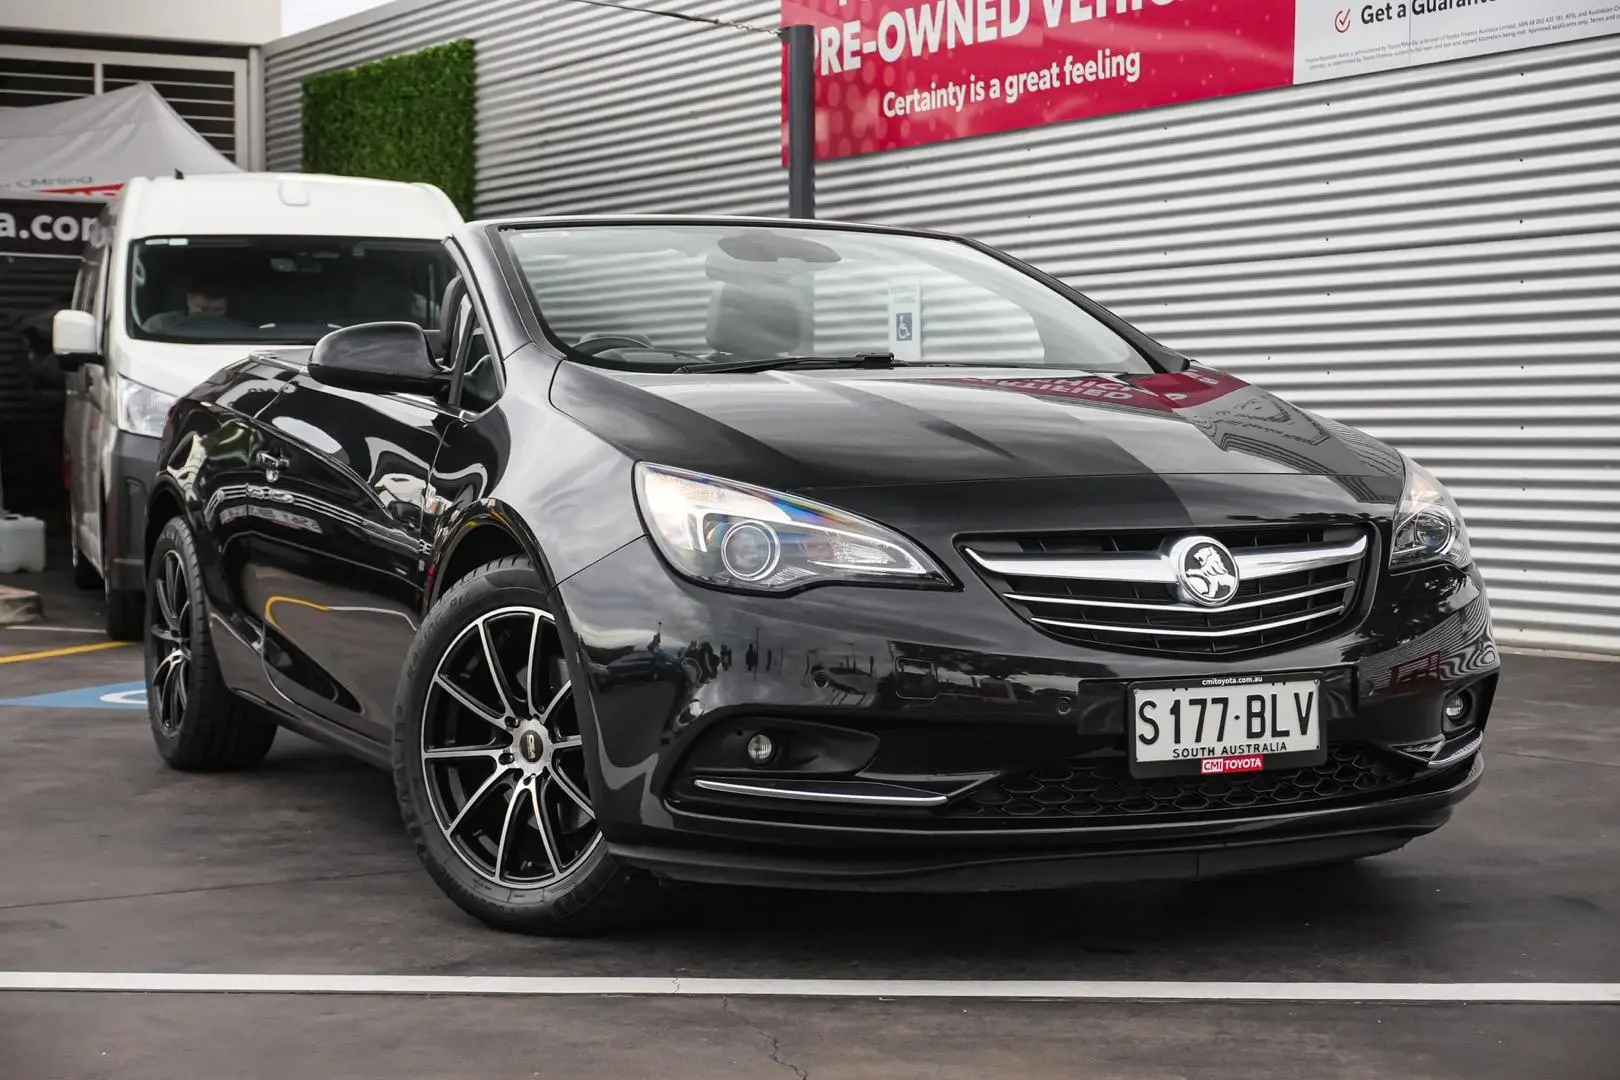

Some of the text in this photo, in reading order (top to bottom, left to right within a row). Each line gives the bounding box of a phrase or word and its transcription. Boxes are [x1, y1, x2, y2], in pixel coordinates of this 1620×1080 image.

[1360, 2, 1393, 25] Get
[1396, 3, 1407, 18] a
[814, 0, 1030, 76] RE-OWNED
[883, 48, 1141, 117] Certainty is a great feeling
[1201, 676, 1263, 686] cmitoyota.com.au
[1172, 741, 1287, 759] SOUTH AUSTRALIA
[1203, 757, 1262, 772] CMI TOYOTA
